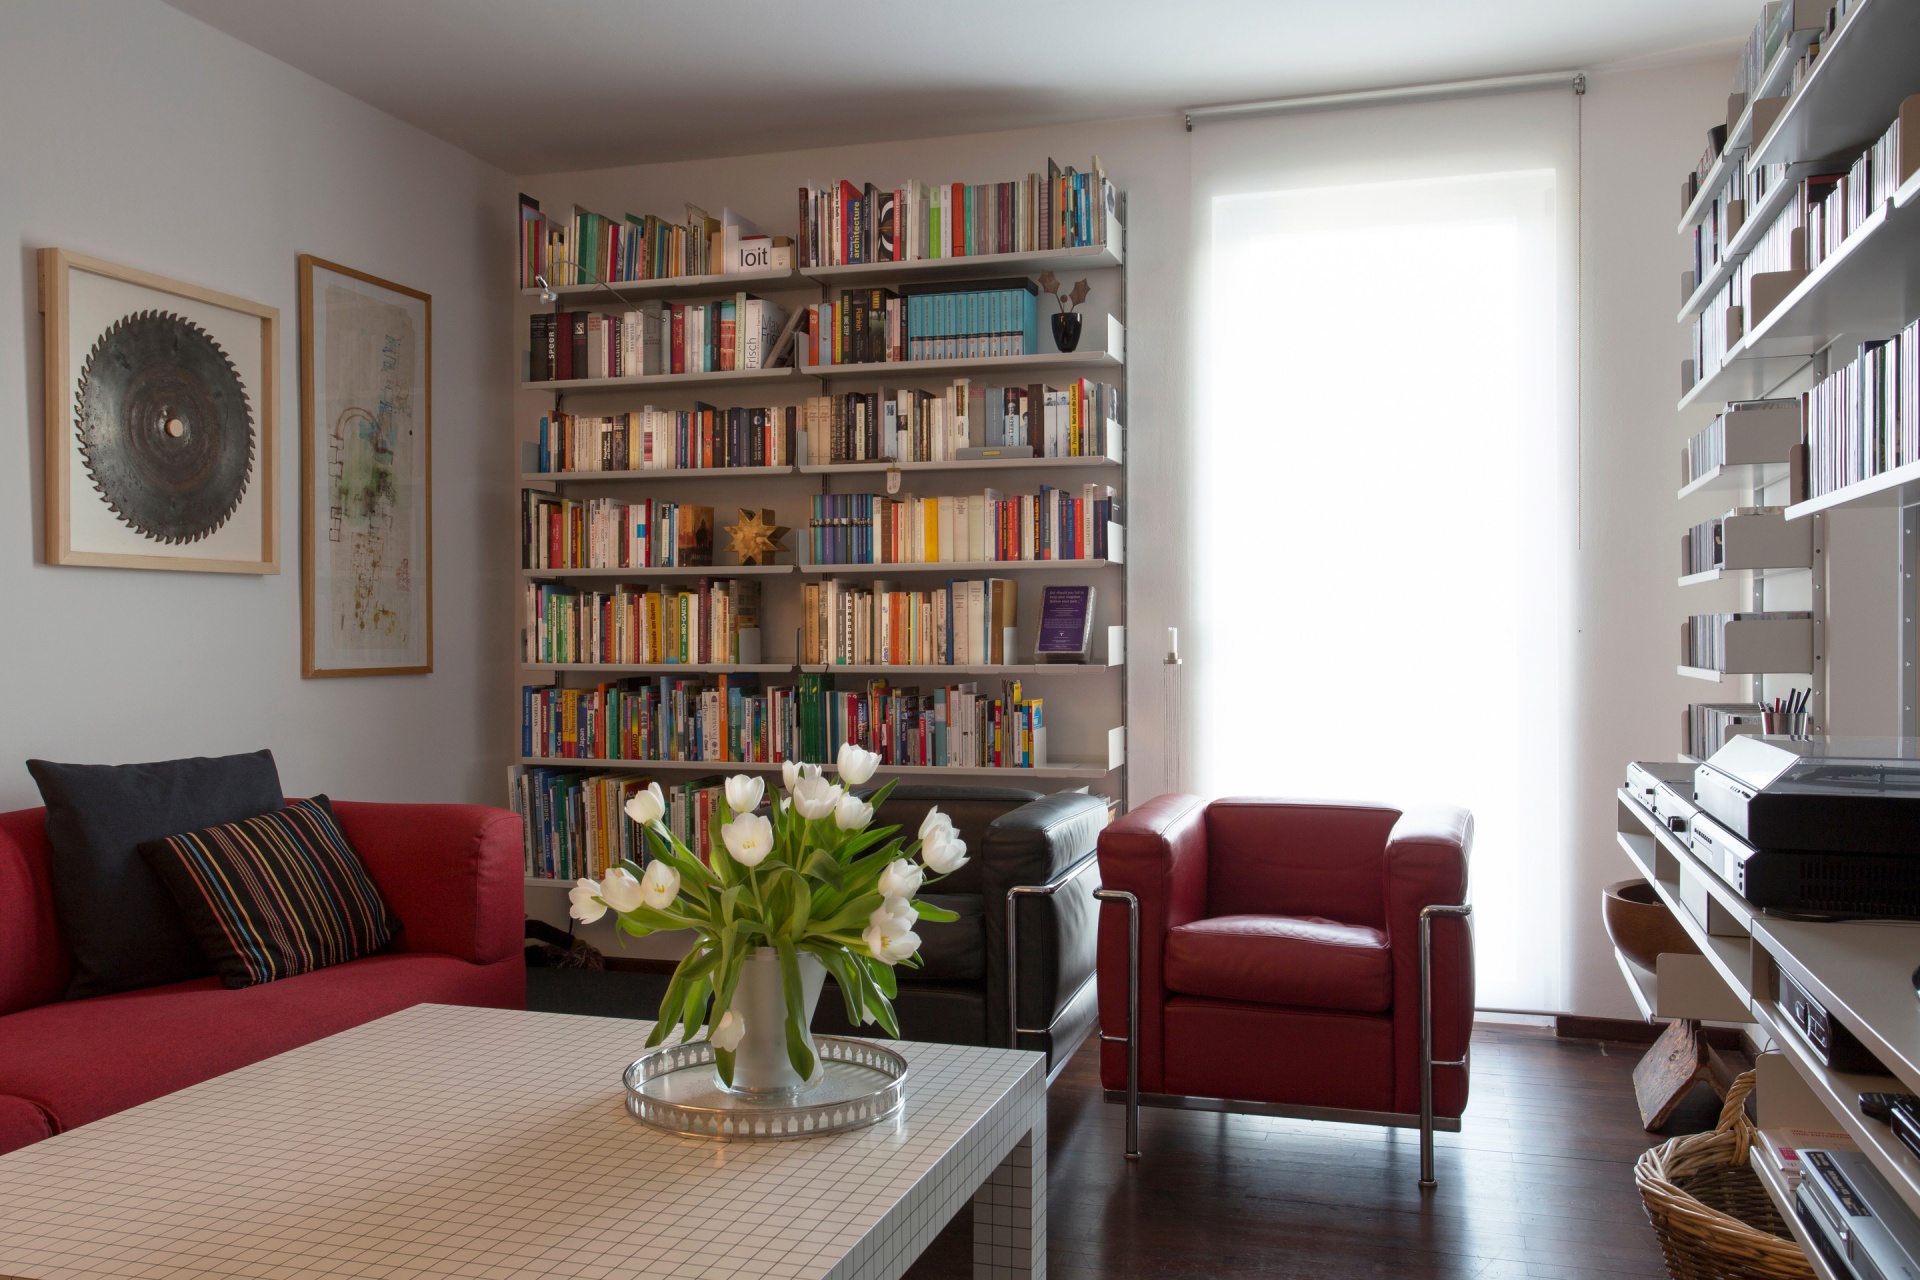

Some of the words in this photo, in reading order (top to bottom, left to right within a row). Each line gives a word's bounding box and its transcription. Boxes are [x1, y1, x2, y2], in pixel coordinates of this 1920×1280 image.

[740, 247, 768, 267] loit
[746, 337, 756, 369] Frisch
[651, 621, 656, 629] am
[578, 727, 586, 748] Japan
[588, 782, 596, 804] FRANCE
[590, 804, 596, 813] DE
